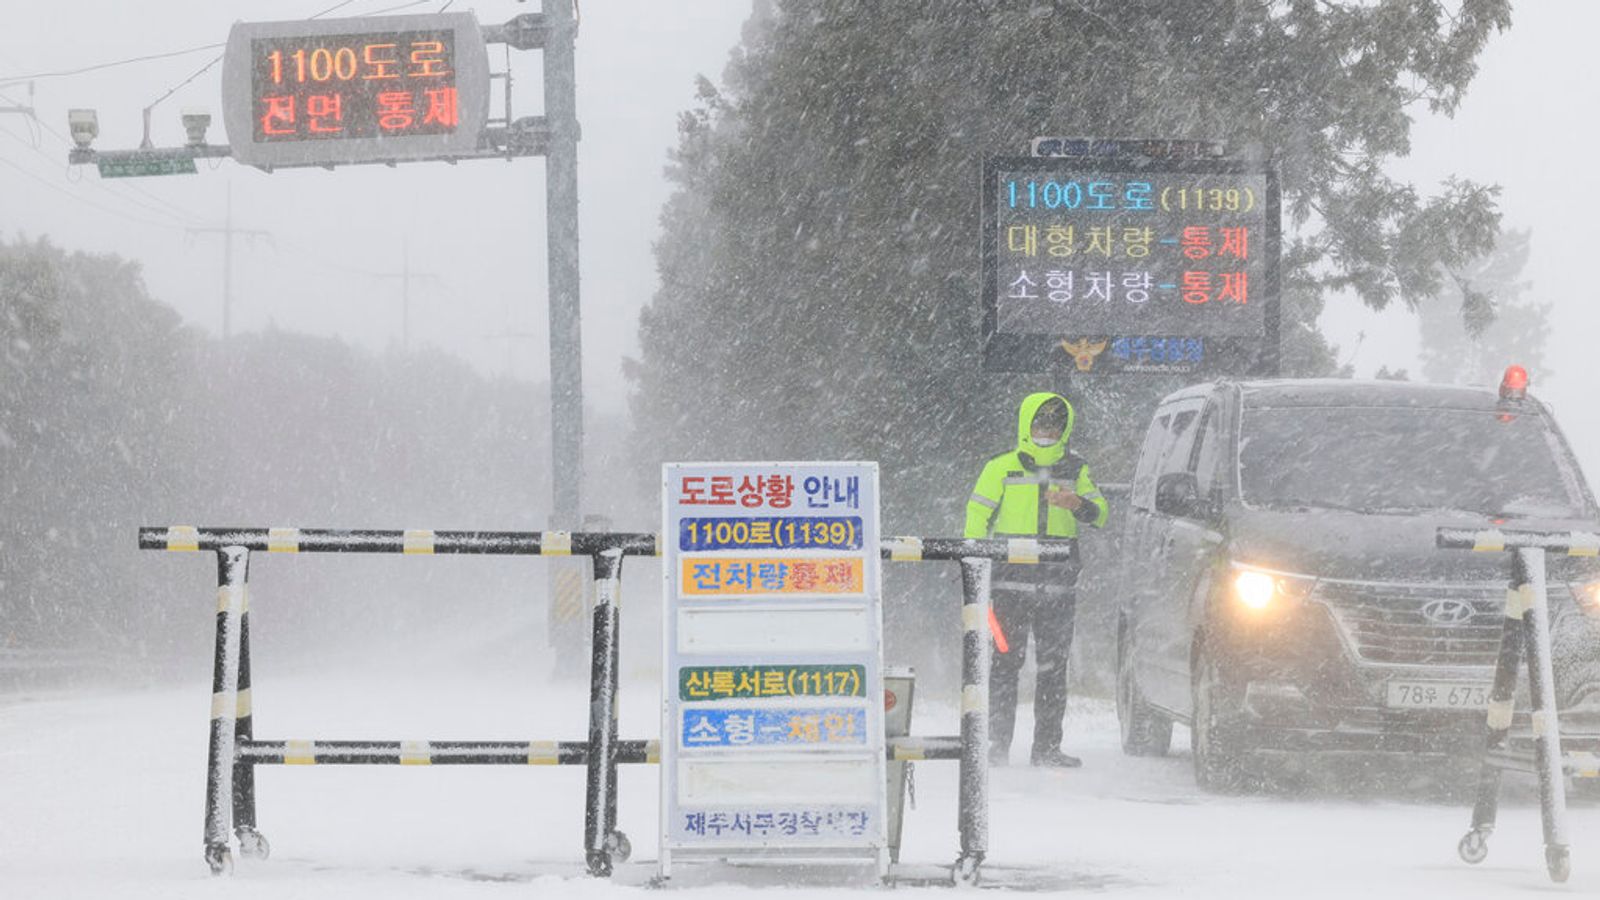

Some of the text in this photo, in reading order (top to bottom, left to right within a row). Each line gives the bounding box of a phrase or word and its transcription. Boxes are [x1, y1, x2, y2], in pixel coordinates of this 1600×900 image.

[267, 41, 452, 84] 1100도로
[260, 86, 459, 135] 전면 통제
[679, 475, 859, 509] 도로상황 안내
[687, 519, 855, 546] 1100로(1139)
[686, 669, 860, 697] 산록서로(1117)
